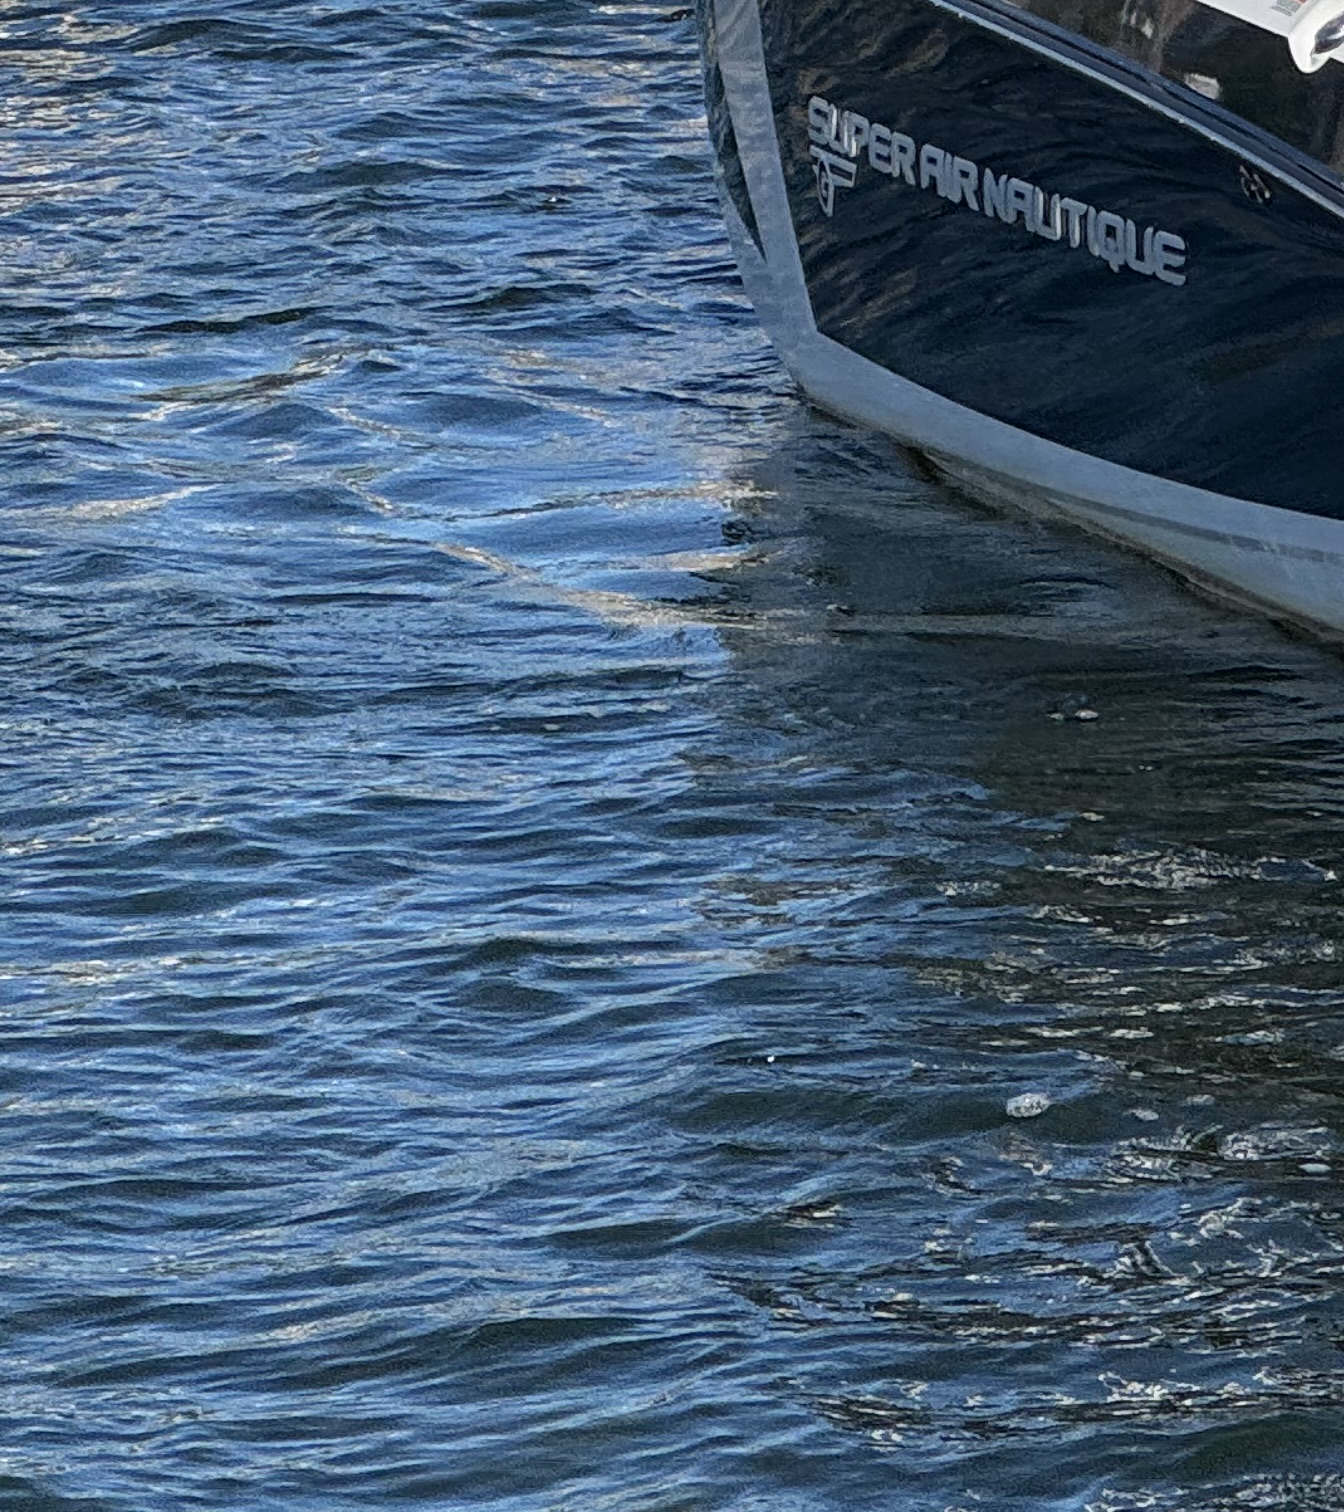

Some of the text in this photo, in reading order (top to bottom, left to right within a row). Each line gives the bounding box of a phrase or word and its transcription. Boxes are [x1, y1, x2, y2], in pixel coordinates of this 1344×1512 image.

[807, 95, 1188, 287] SUPER AIR NAUTIQUE
